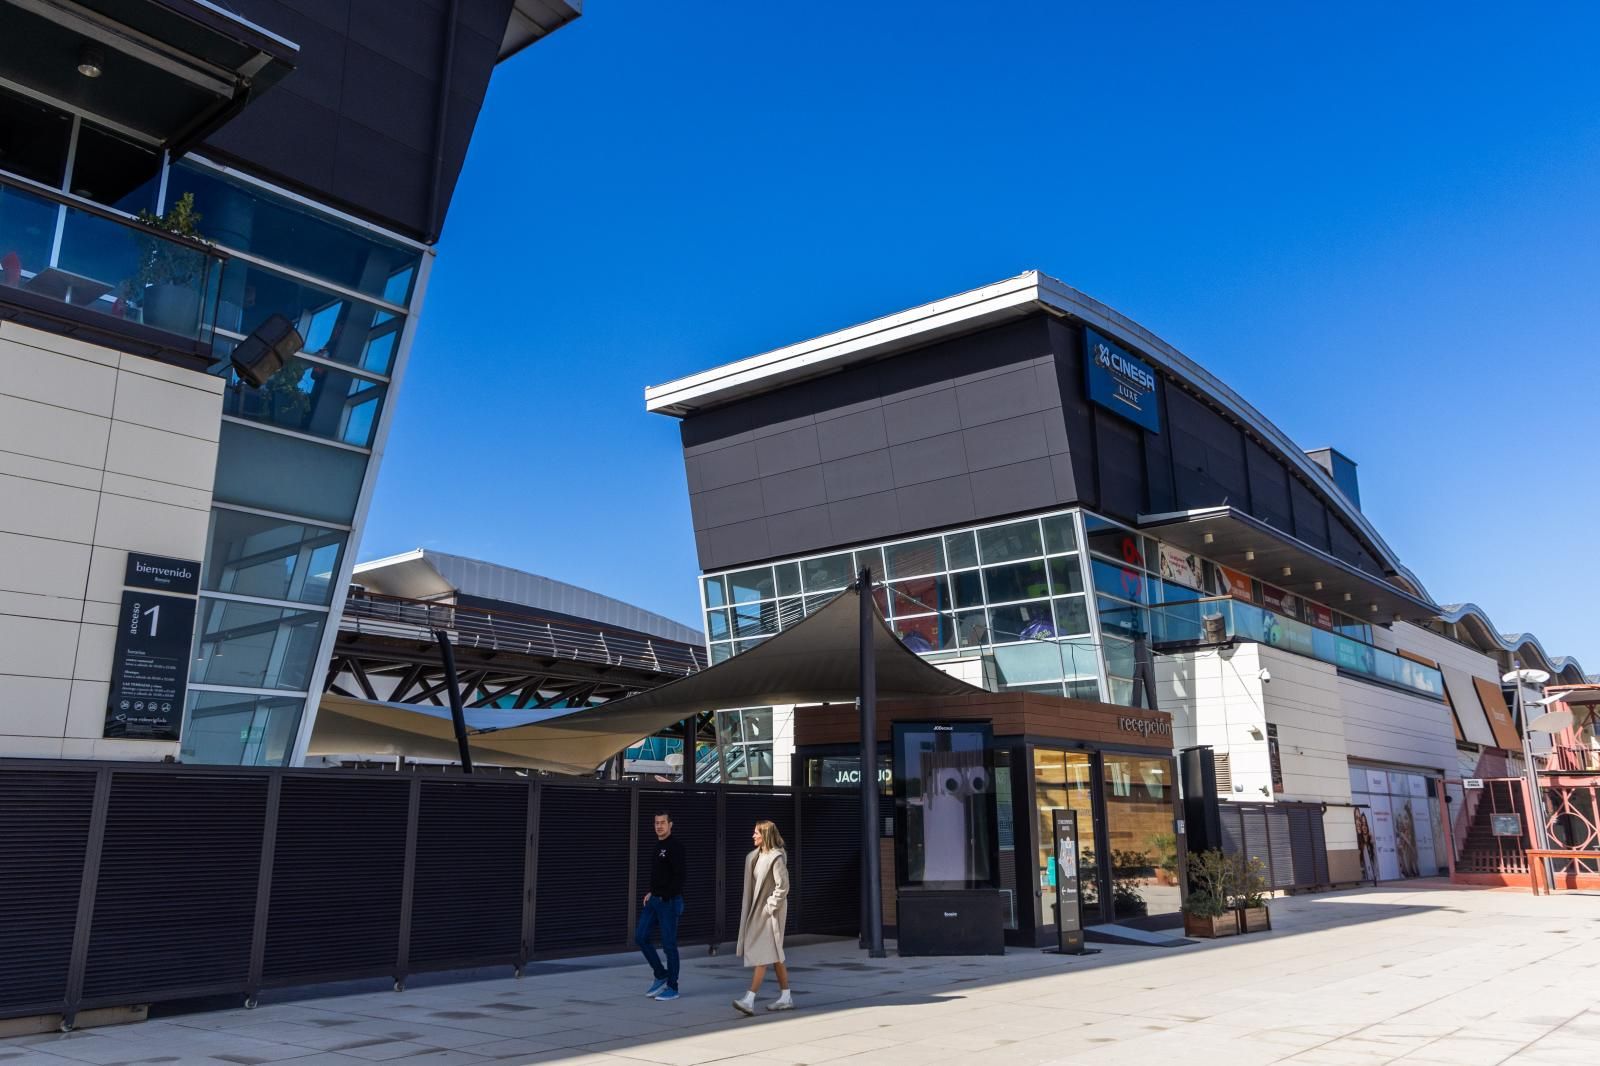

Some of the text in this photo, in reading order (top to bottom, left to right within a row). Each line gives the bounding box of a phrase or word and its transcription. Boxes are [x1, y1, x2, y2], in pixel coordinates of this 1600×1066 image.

[1111, 353, 1155, 392] CINESA
[1119, 384, 1138, 403] LUXE
[136, 561, 192, 579] bienvenido
[130, 603, 141, 635] acceso
[143, 604, 160, 637] 1
[1120, 716, 1171, 737] recepción
[835, 769, 893, 783] JAC JO
